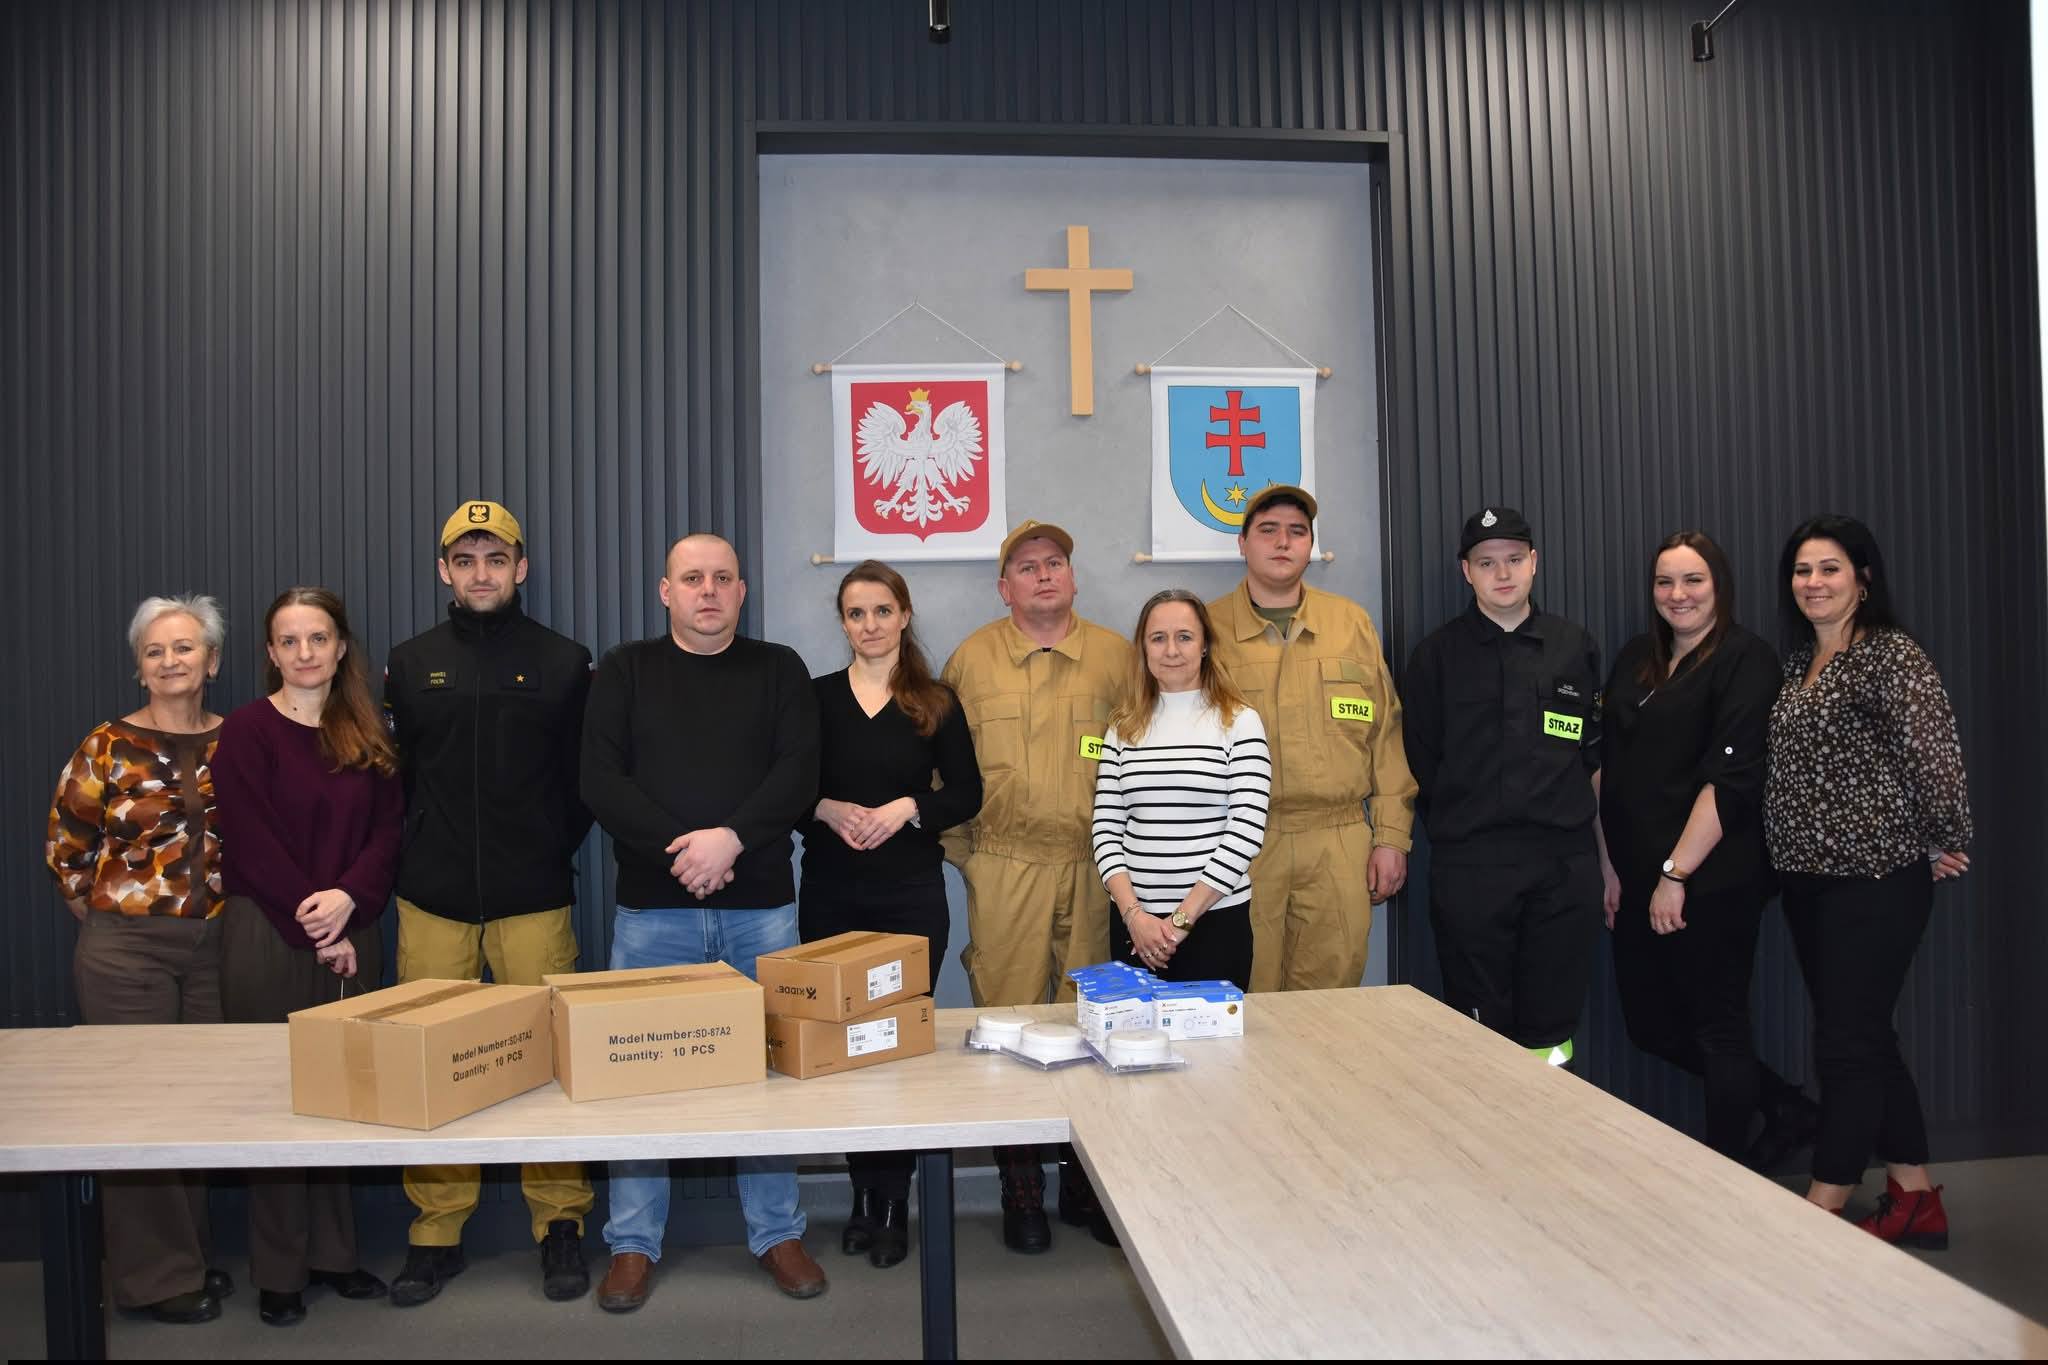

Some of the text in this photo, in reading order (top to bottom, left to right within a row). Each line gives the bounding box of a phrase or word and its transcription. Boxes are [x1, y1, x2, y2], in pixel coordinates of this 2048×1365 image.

[609, 1033, 644, 1045] Model
[452, 1047, 477, 1063] Model
[609, 1044, 716, 1063] Quantity: 10 PCS
[452, 1049, 524, 1082] Quantity: 10 PCS
